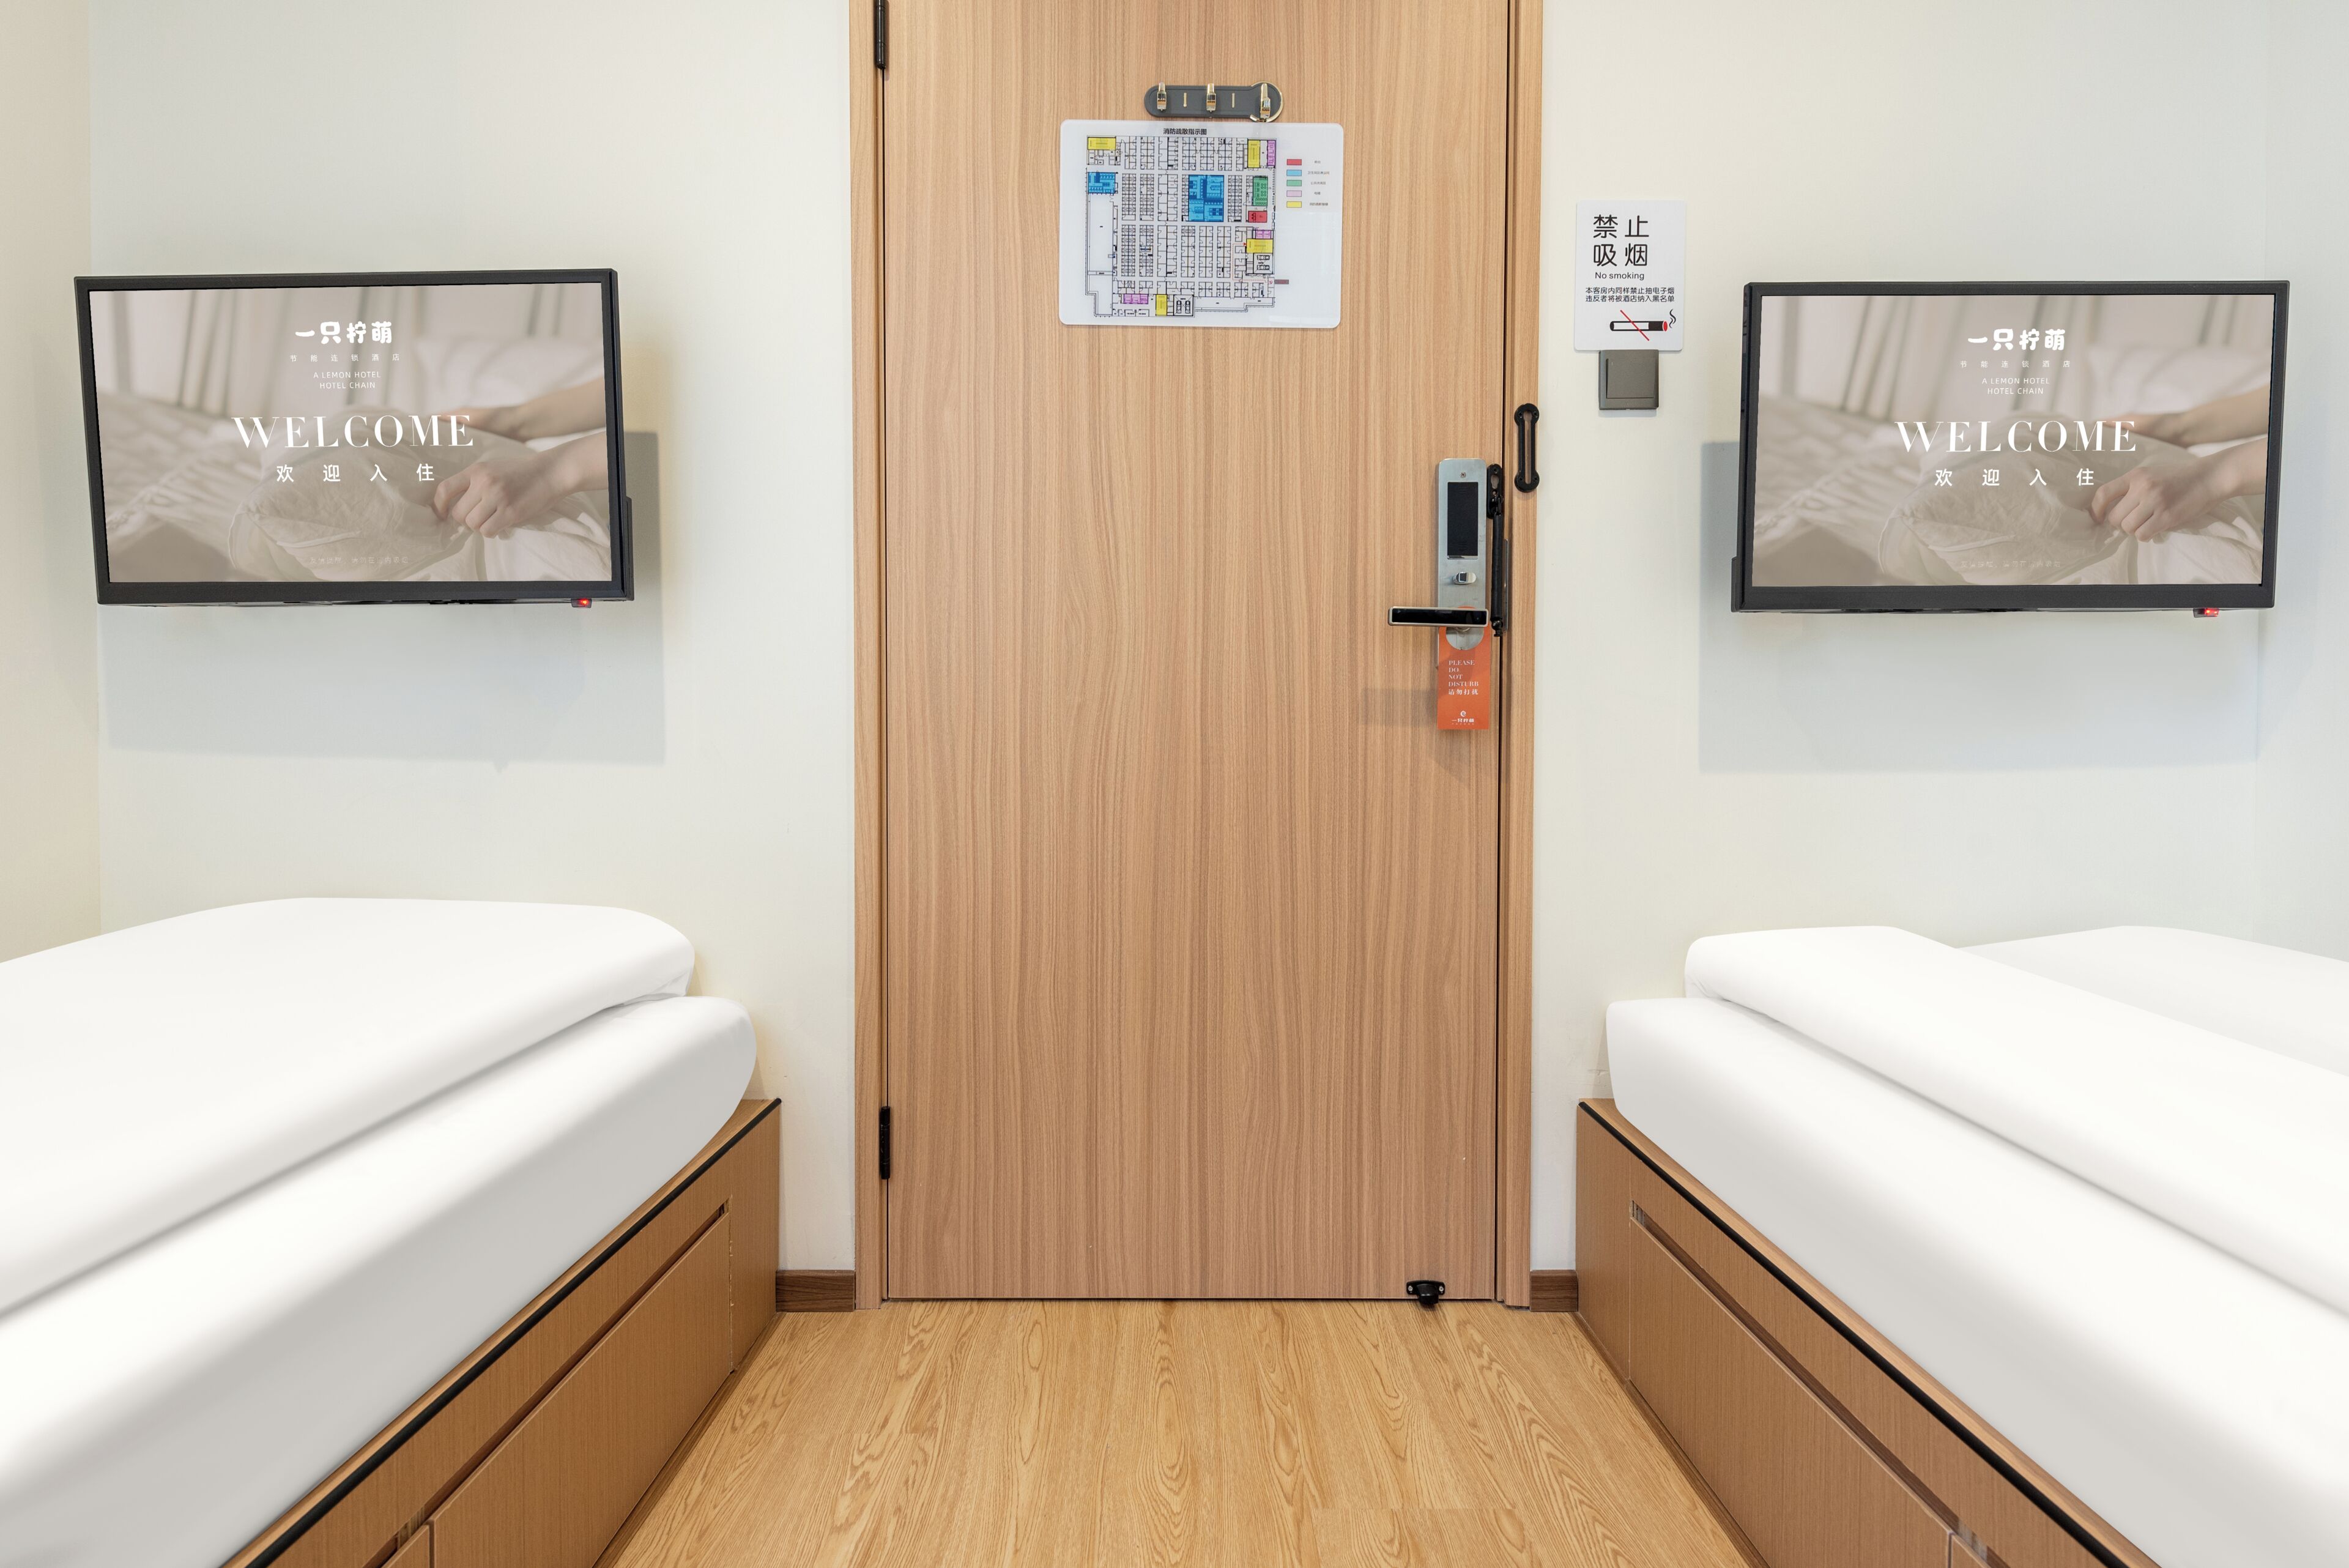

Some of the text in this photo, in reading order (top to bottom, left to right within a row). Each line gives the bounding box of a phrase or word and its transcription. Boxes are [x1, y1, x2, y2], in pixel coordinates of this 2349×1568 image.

[1609, 272, 1644, 281] smoking
[290, 354, 399, 362] 节能连锁酒店
[231, 415, 473, 448] WELCOME
[1894, 421, 2136, 452] WELCOME
[276, 463, 435, 483] 欢迎入住
[1934, 469, 2094, 486] 欢迎入住
